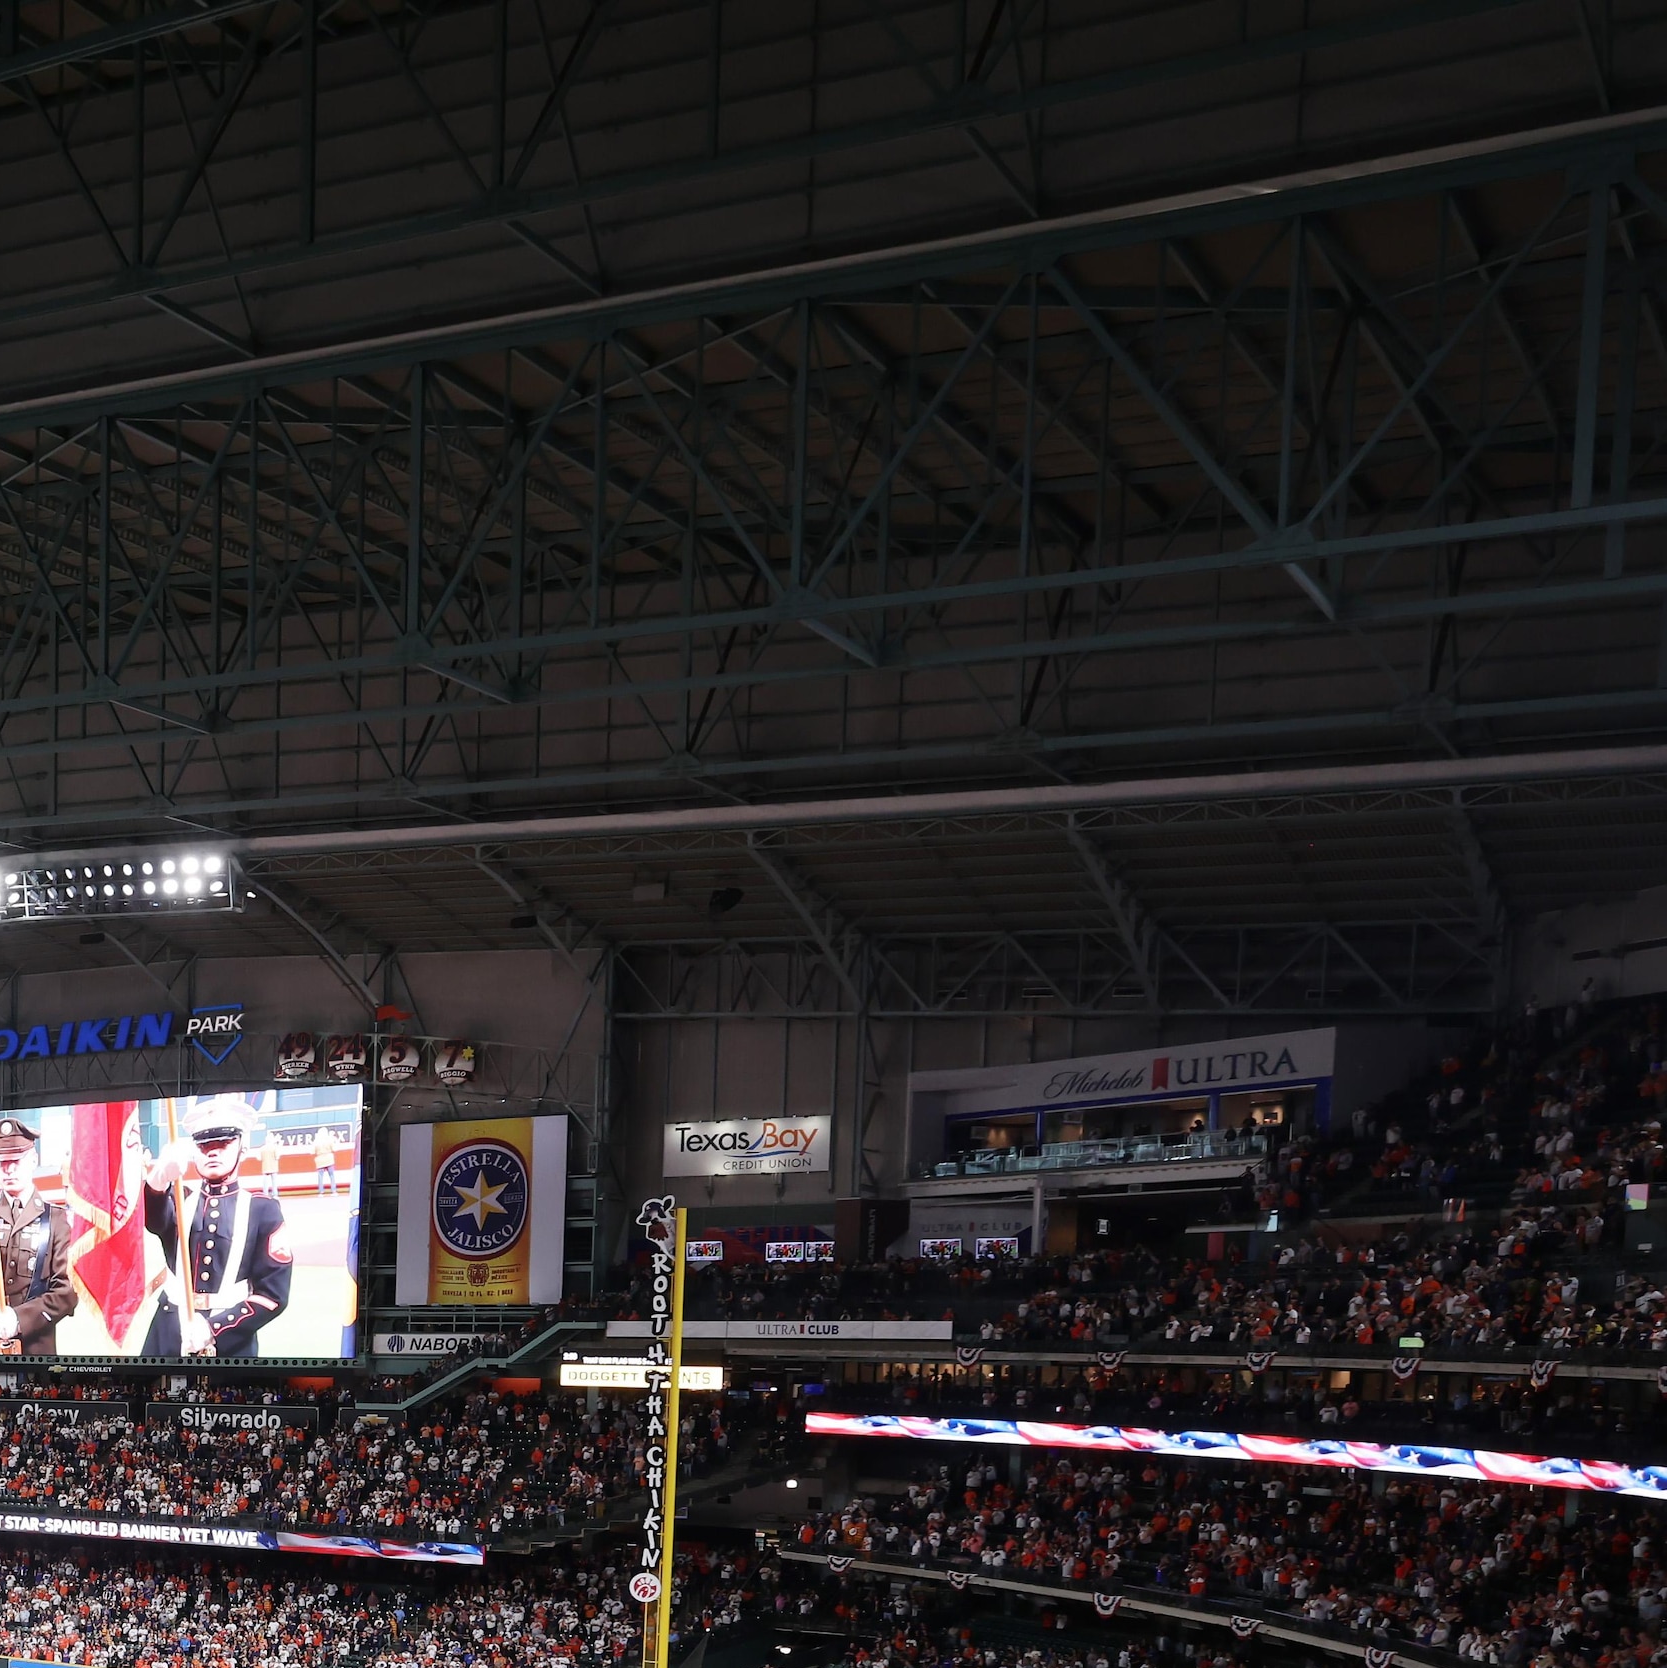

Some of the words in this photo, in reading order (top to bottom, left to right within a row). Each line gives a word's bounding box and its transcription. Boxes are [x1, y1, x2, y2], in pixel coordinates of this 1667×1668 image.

[186, 1013, 245, 1035] PARK
[389, 1037, 406, 1064] 5
[1044, 1068, 1146, 1098] Michelob
[1175, 1047, 1298, 1085] ULTRA
[675, 1126, 750, 1153] Texas
[762, 1122, 819, 1156] Bay
[443, 1152, 521, 1187] ESTRELLA
[723, 1160, 763, 1171] CREDIT
[768, 1158, 812, 1170] UNION
[447, 1223, 514, 1249] JALISCO
[758, 1324, 797, 1335] ULTRA
[807, 1324, 839, 1335] CLUB
[568, 1371, 638, 1383] DOGGETT
[5, 1515, 118, 1537] STAR-SPANGLED
[120, 1523, 181, 1541] BANNER
[182, 1526, 210, 1543] YET
[212, 1529, 258, 1546] WAVE
